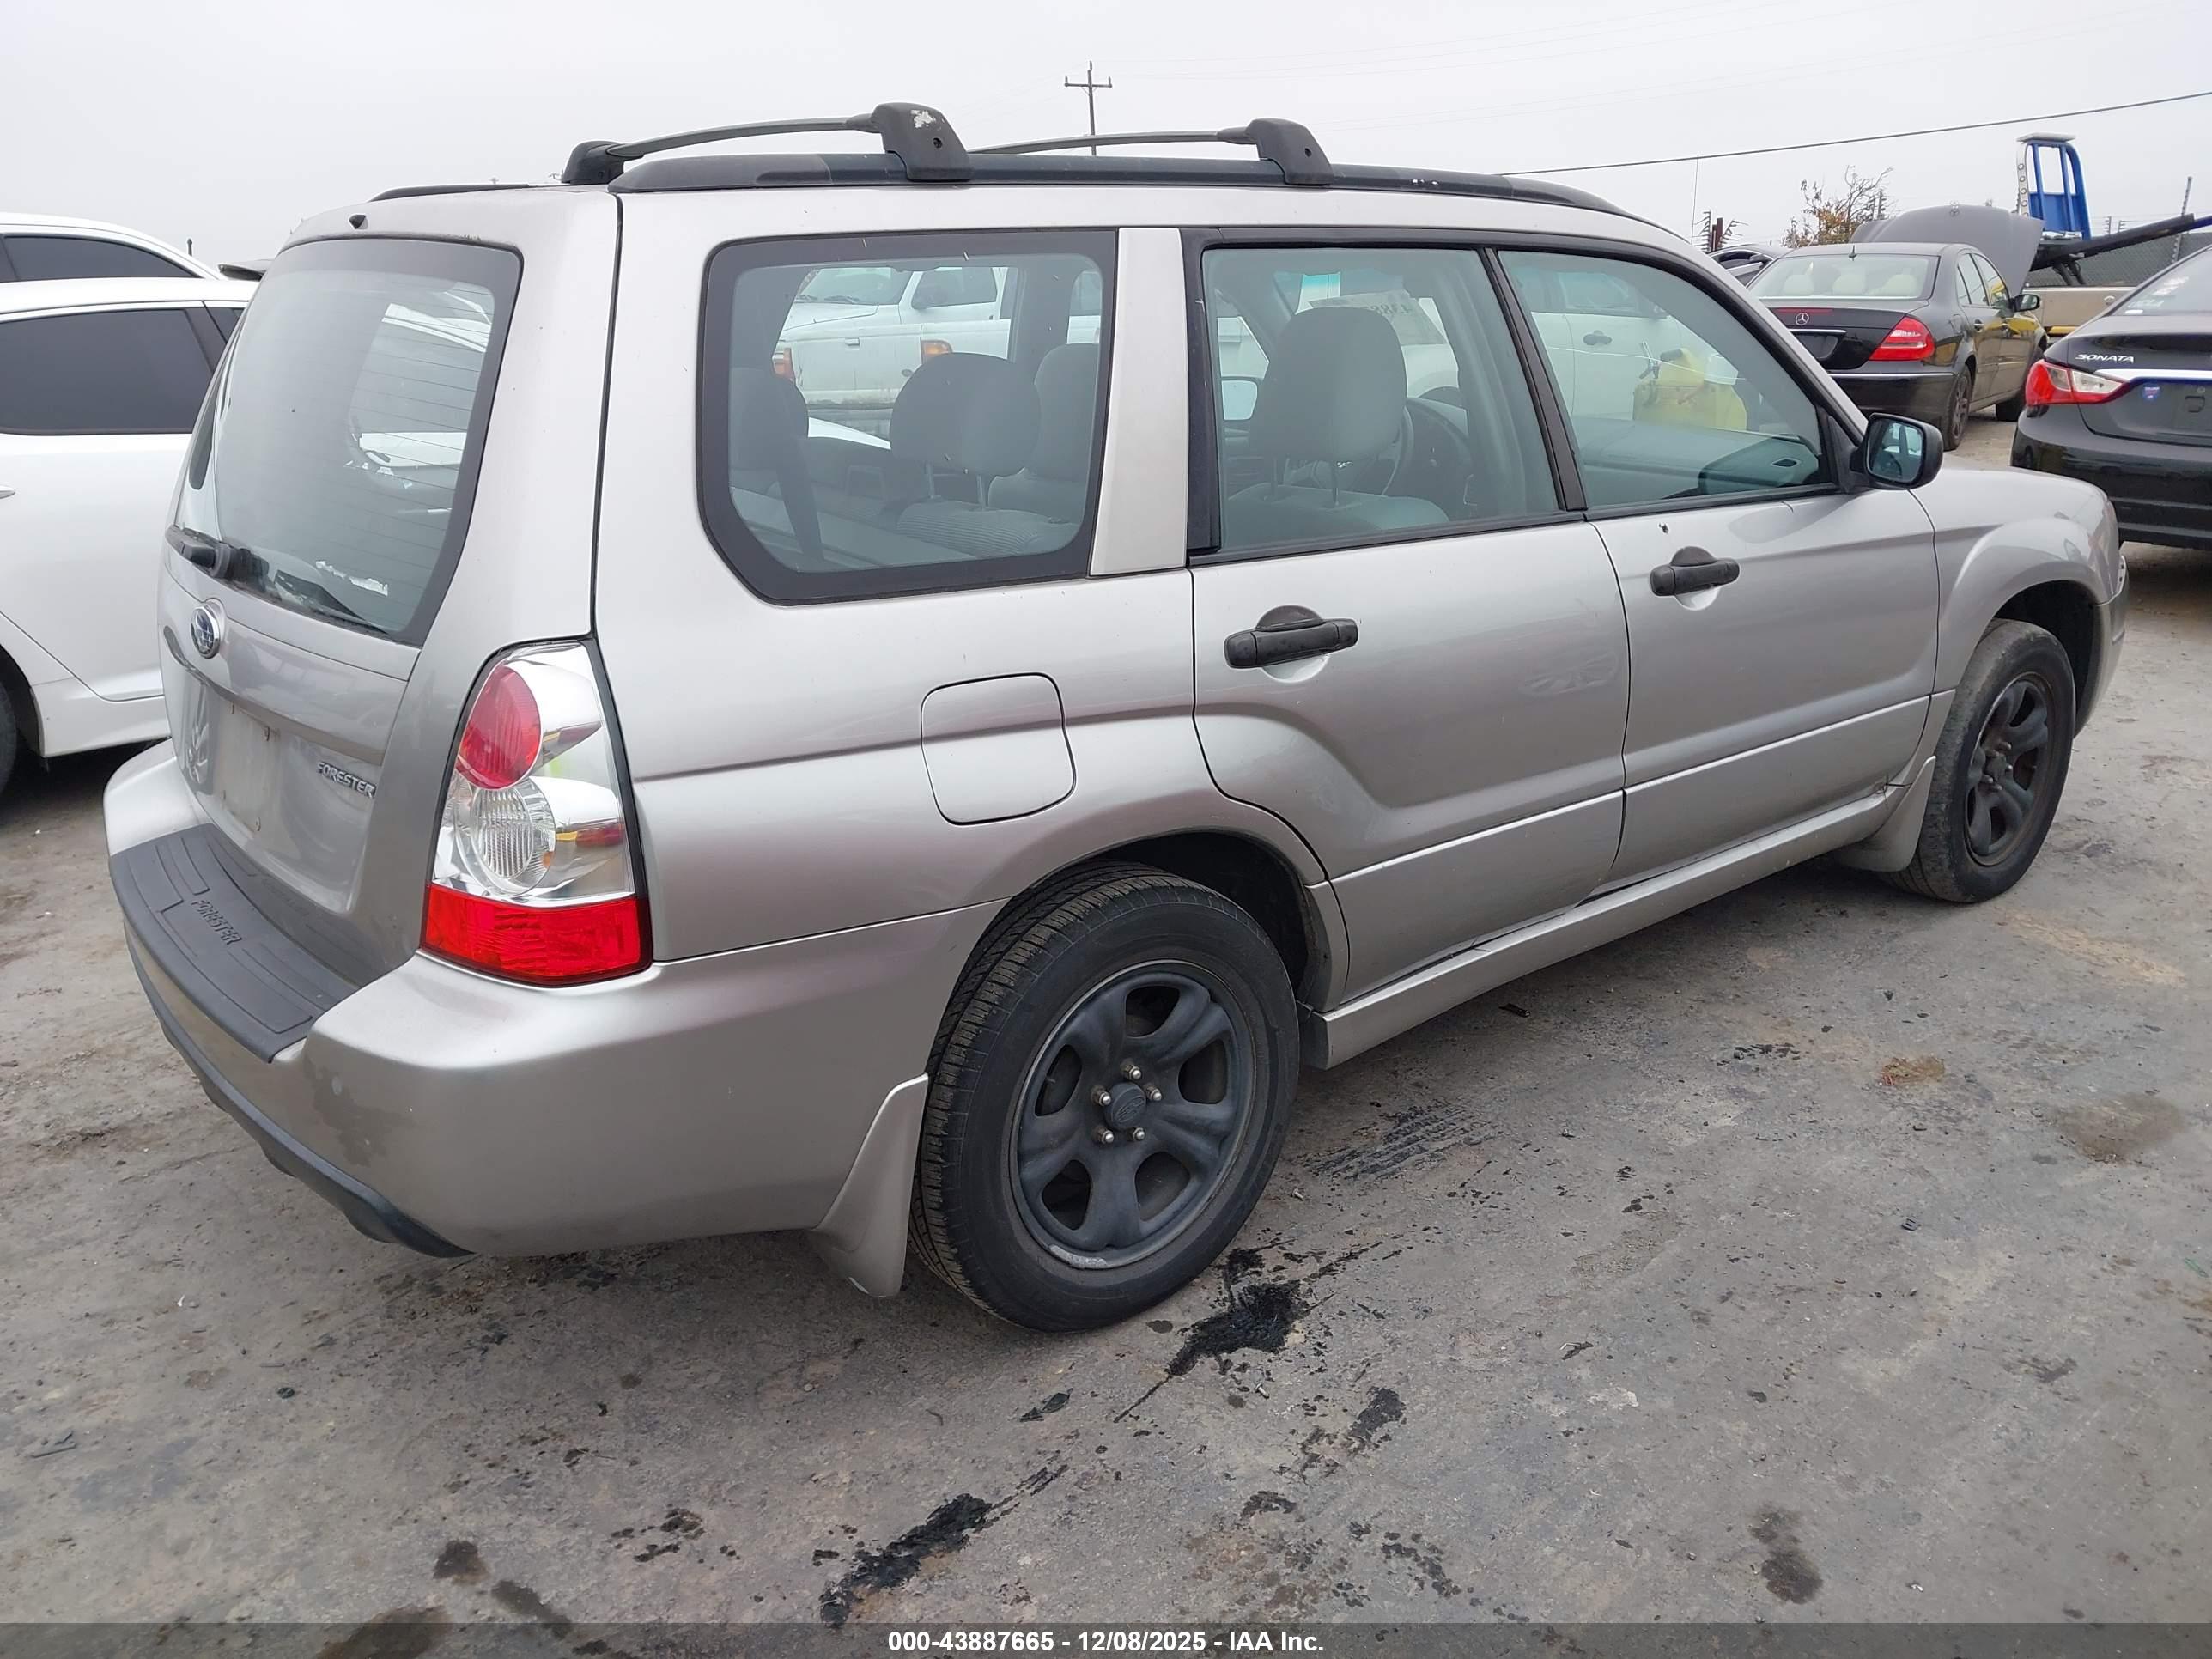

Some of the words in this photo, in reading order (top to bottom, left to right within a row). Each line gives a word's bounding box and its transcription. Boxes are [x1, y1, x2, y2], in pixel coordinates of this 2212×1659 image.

[2075, 353, 2135, 364] SONATA
[316, 761, 377, 799] FORESTER
[191, 900, 242, 945] FORESTER
